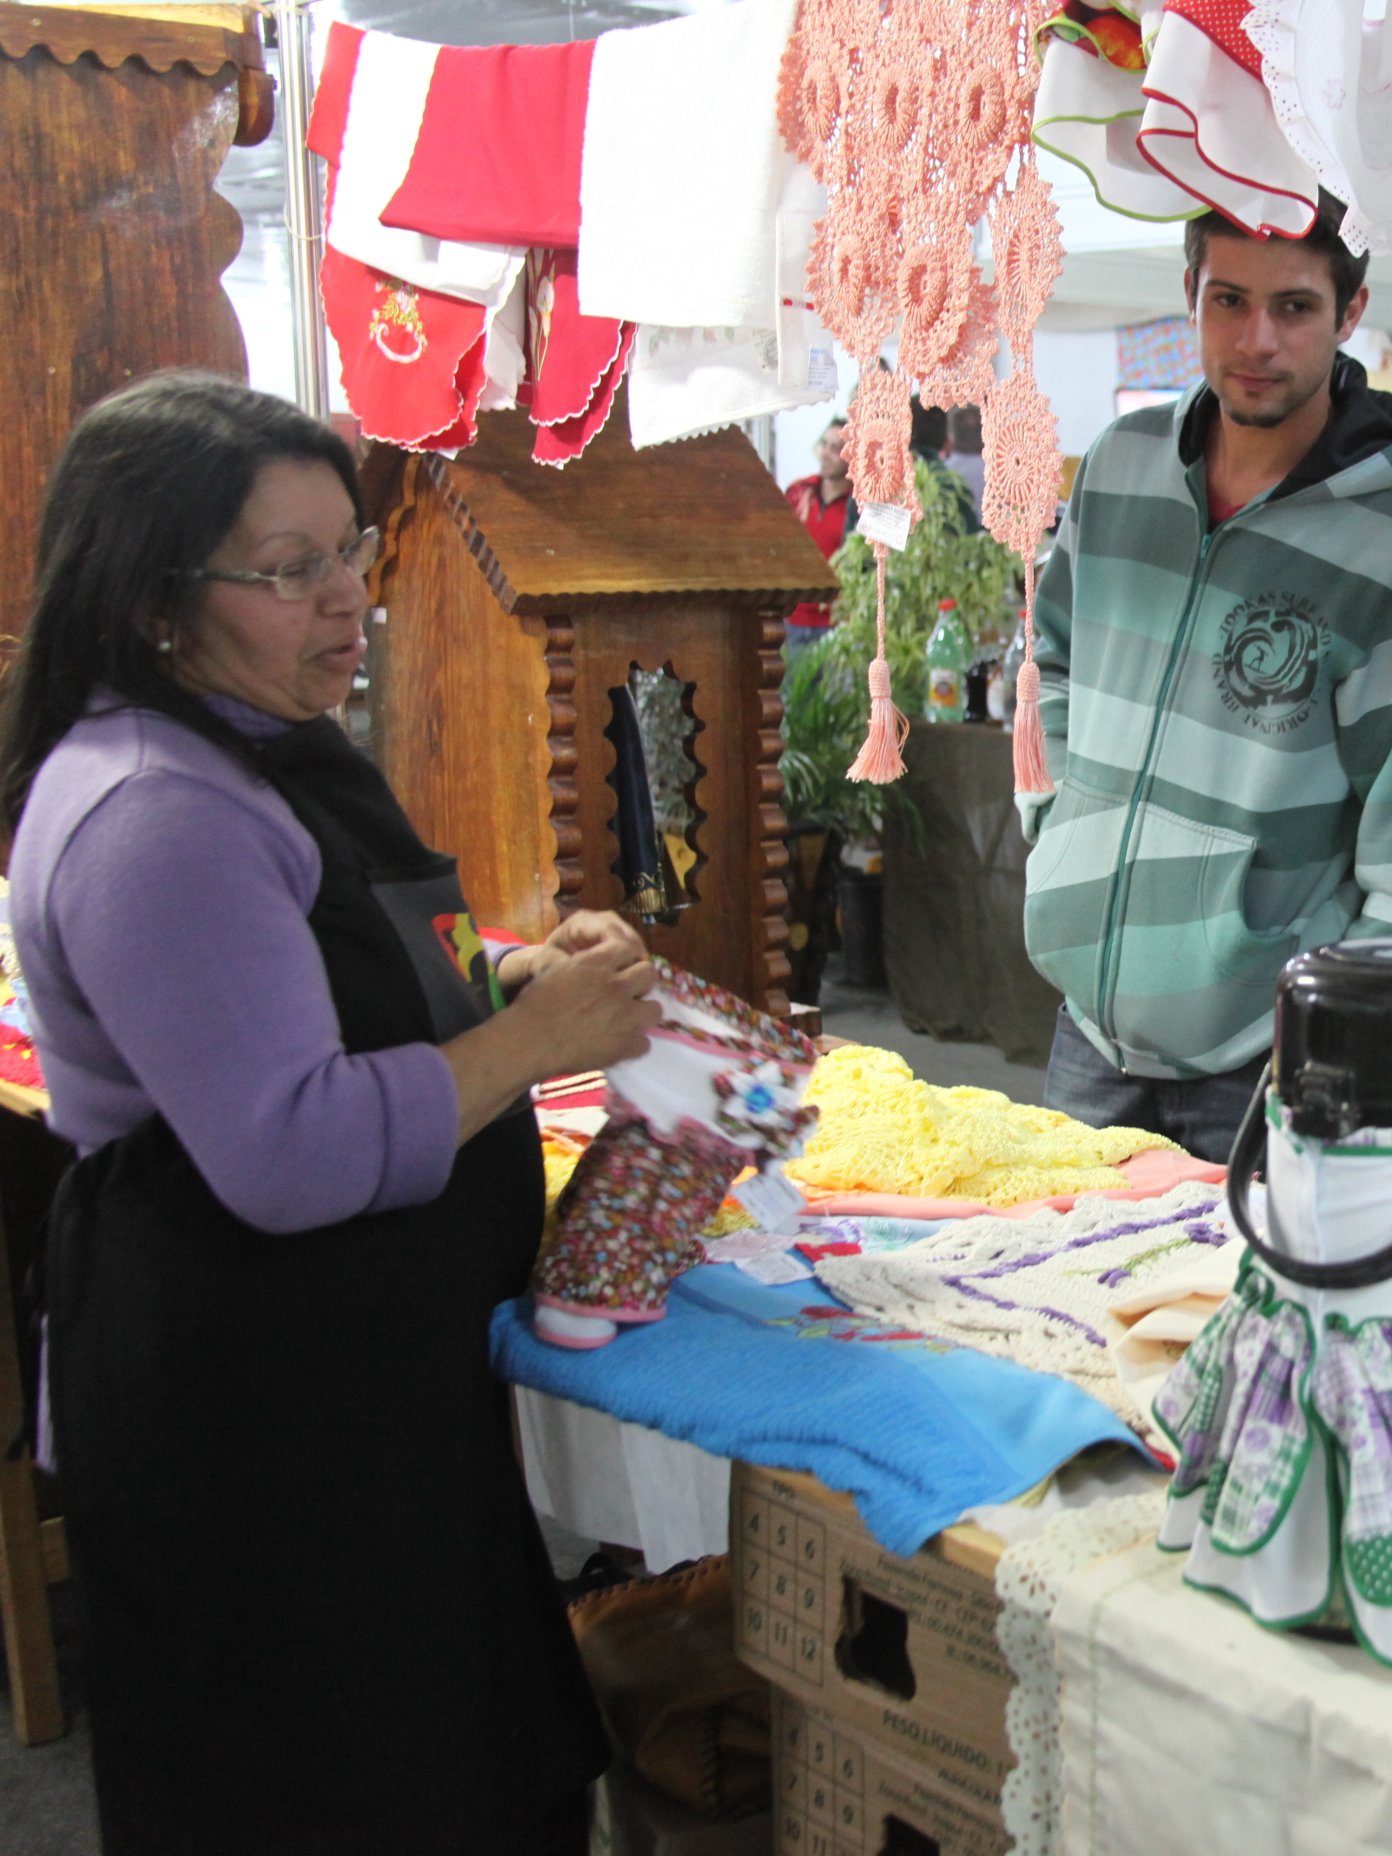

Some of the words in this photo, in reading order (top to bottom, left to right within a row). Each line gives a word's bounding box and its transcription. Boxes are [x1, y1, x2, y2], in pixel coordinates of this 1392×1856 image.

[748, 1513, 759, 1533] 4
[777, 1525, 787, 1546] 5
[804, 1539, 815, 1560] 6
[748, 1560, 760, 1580] 7
[776, 1574, 787, 1596] 8
[804, 1587, 815, 1609] 9
[747, 1608, 763, 1633] 10
[774, 1622, 788, 1646] 11
[801, 1636, 816, 1662] 12
[883, 1709, 920, 1741] PESO
[815, 1742, 824, 1763] 5
[843, 1758, 854, 1779] 6
[814, 1788, 825, 1808] 8
[843, 1804, 854, 1825] 9
